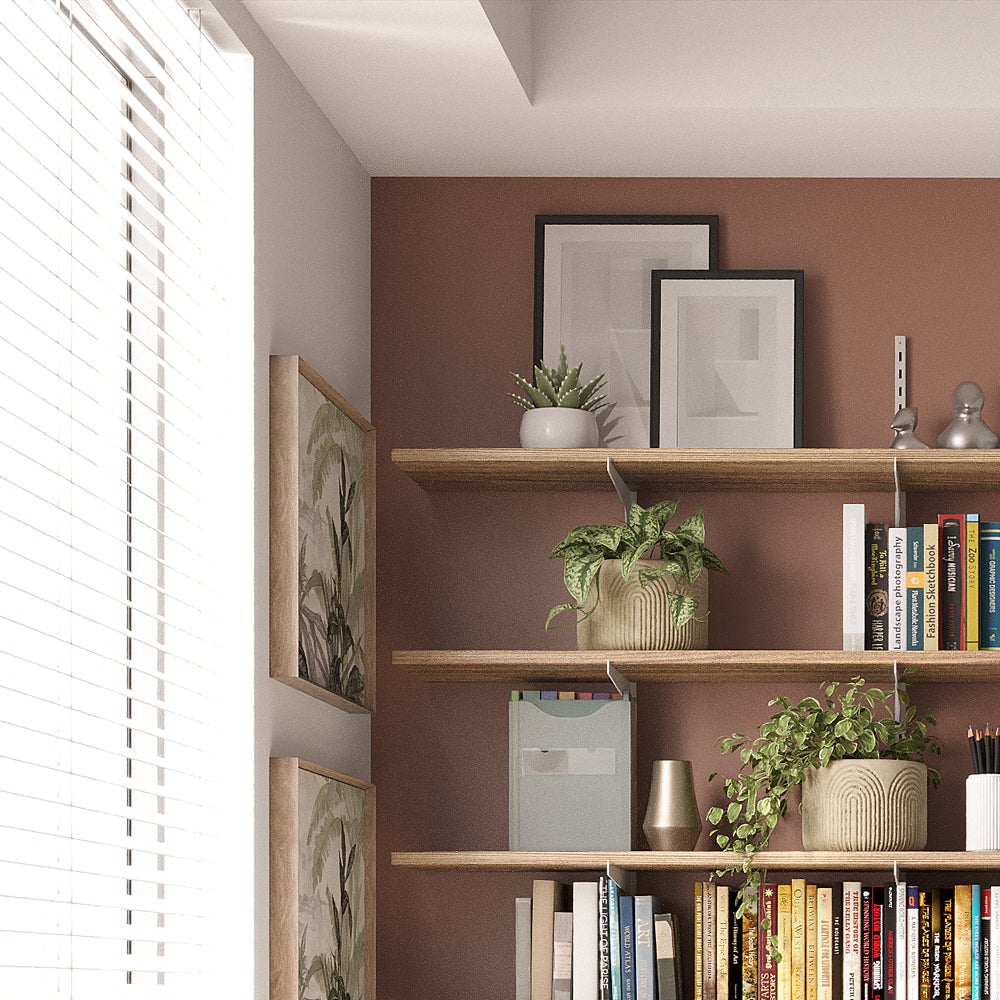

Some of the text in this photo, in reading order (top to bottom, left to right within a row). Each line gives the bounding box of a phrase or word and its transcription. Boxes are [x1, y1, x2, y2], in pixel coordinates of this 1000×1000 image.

[947, 562, 956, 592] MUSICIAN
[893, 536, 903, 649] Landscape photography
[926, 545, 935, 638] Fashion Sketchbook
[872, 619, 883, 641] HARPER
[637, 918, 650, 947] ART
[873, 903, 881, 990] SPINNING WORLD HISTORY
[718, 939, 726, 955] Epic
[640, 959, 648, 987] HISTORY
[718, 958, 727, 979] Cycle
[932, 963, 940, 999] WARRIOR
[958, 962, 966, 985] PIPER
[640, 988, 648, 1000] OF
